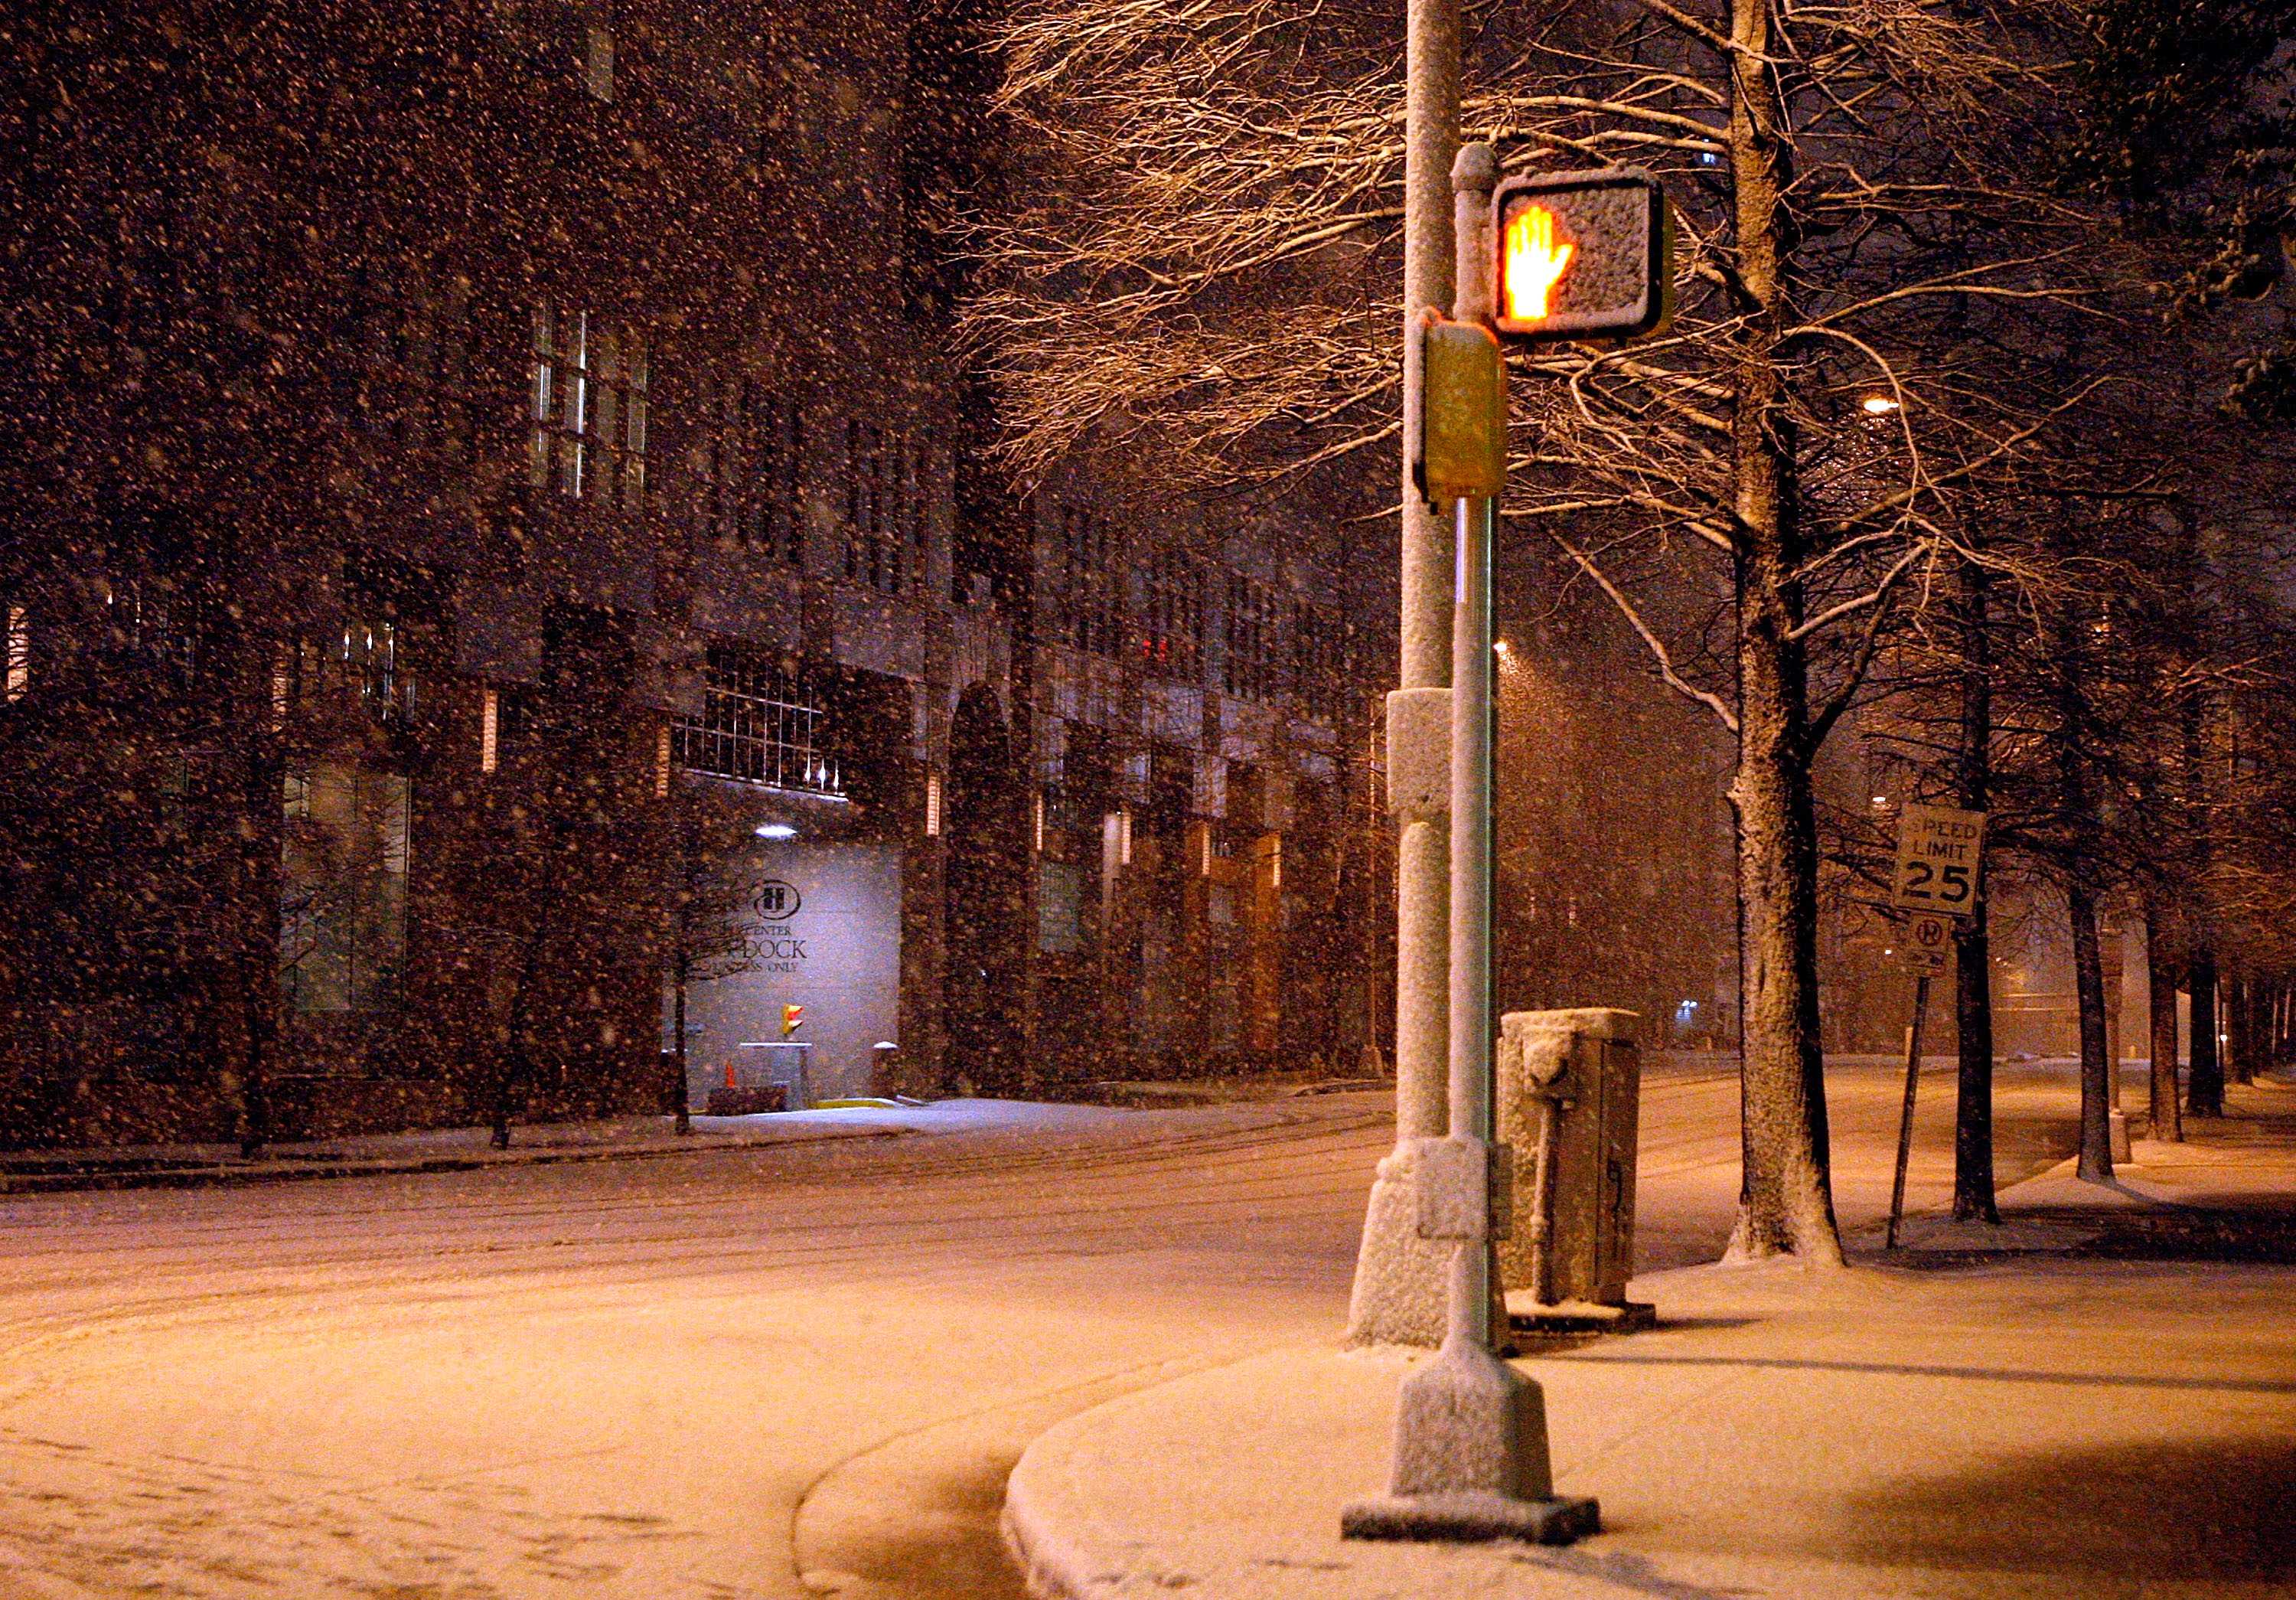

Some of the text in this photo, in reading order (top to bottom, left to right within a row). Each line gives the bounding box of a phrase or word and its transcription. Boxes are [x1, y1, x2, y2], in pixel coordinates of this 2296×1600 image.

[1913, 819, 1977, 839] SPEED
[1913, 840, 1968, 860] LIMIT
[1903, 860, 1970, 903] 25
[743, 939, 808, 959] DOCK
[768, 962, 799, 973] ONLY
